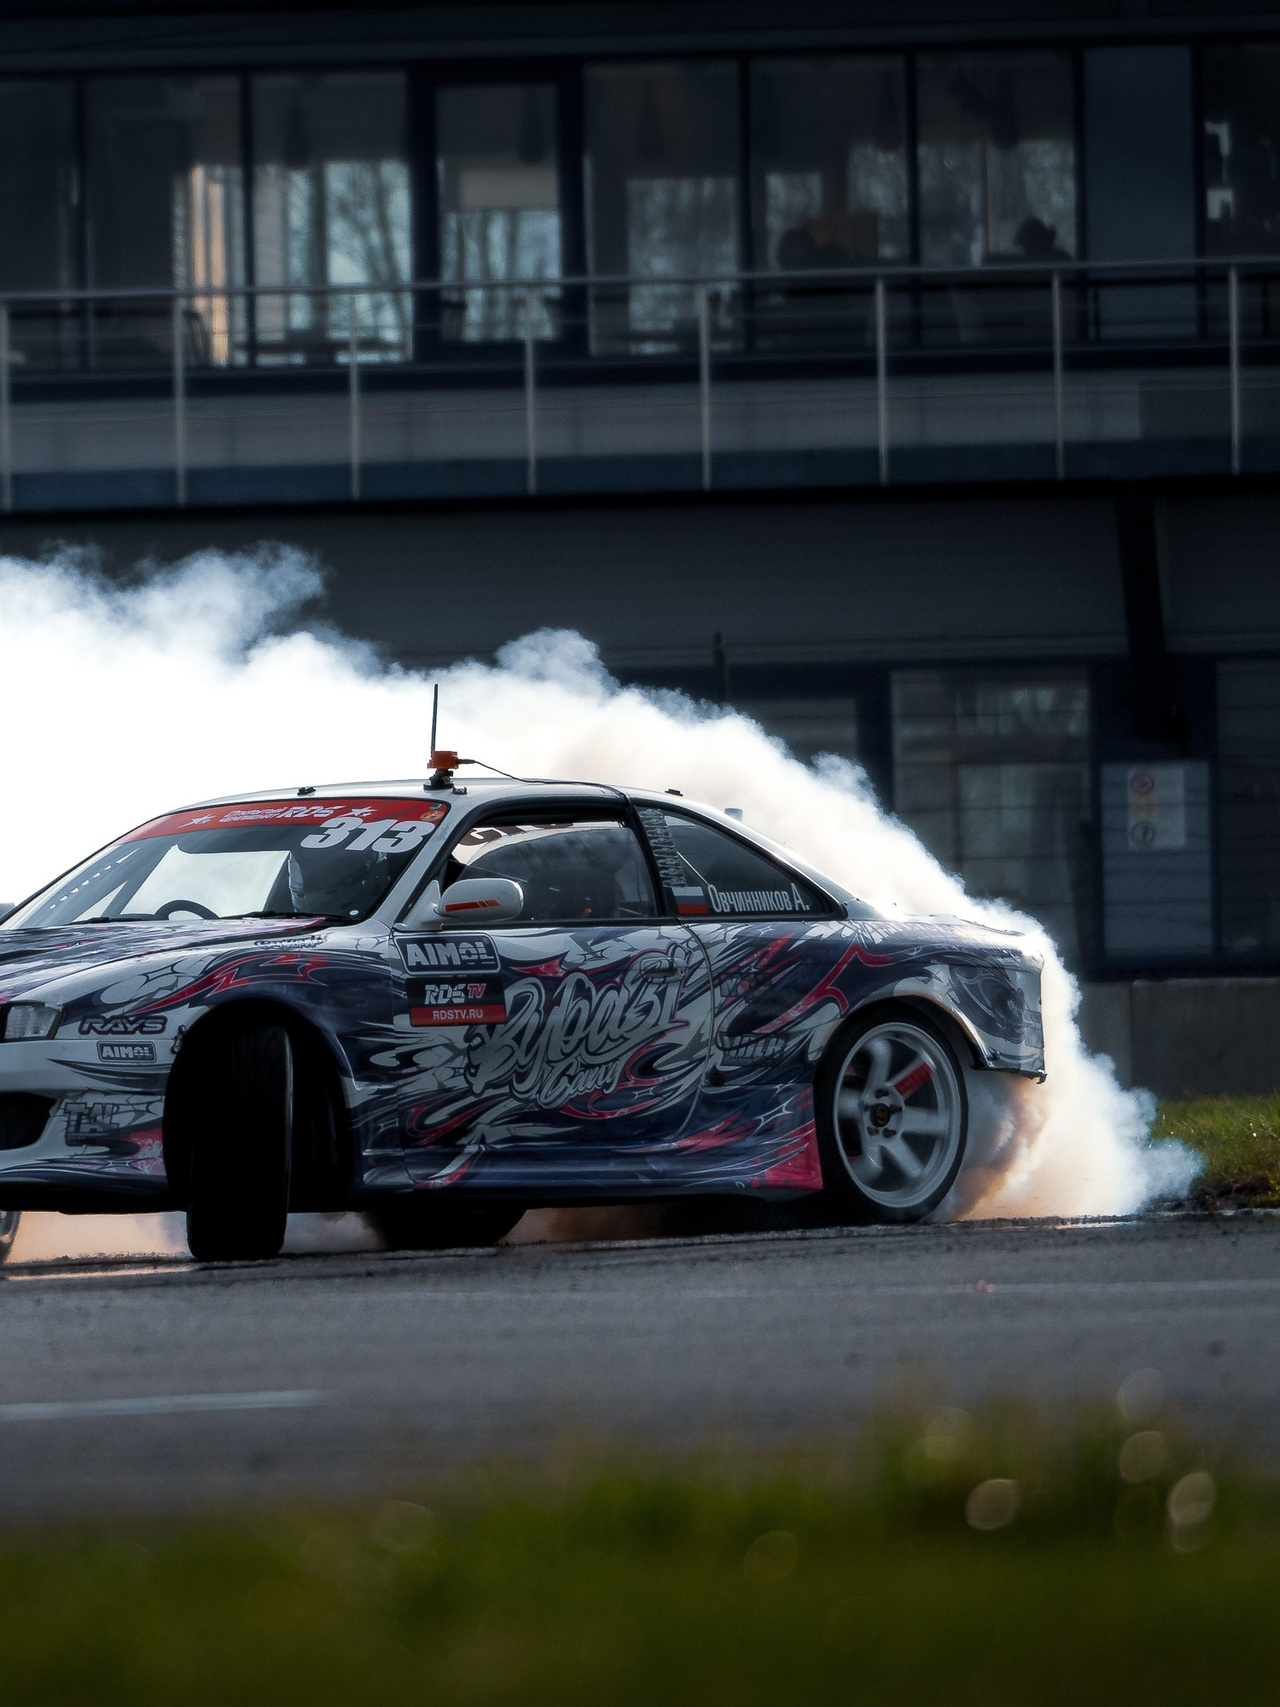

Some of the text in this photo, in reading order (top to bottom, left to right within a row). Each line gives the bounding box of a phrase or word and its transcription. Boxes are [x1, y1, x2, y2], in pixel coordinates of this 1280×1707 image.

[300, 816, 436, 853] 313
[406, 941, 496, 966] AIMOL
[432, 1008, 484, 1020] RDSTV.RU
[79, 1016, 167, 1034] RAYS
[101, 1045, 155, 1059] AIMOL
